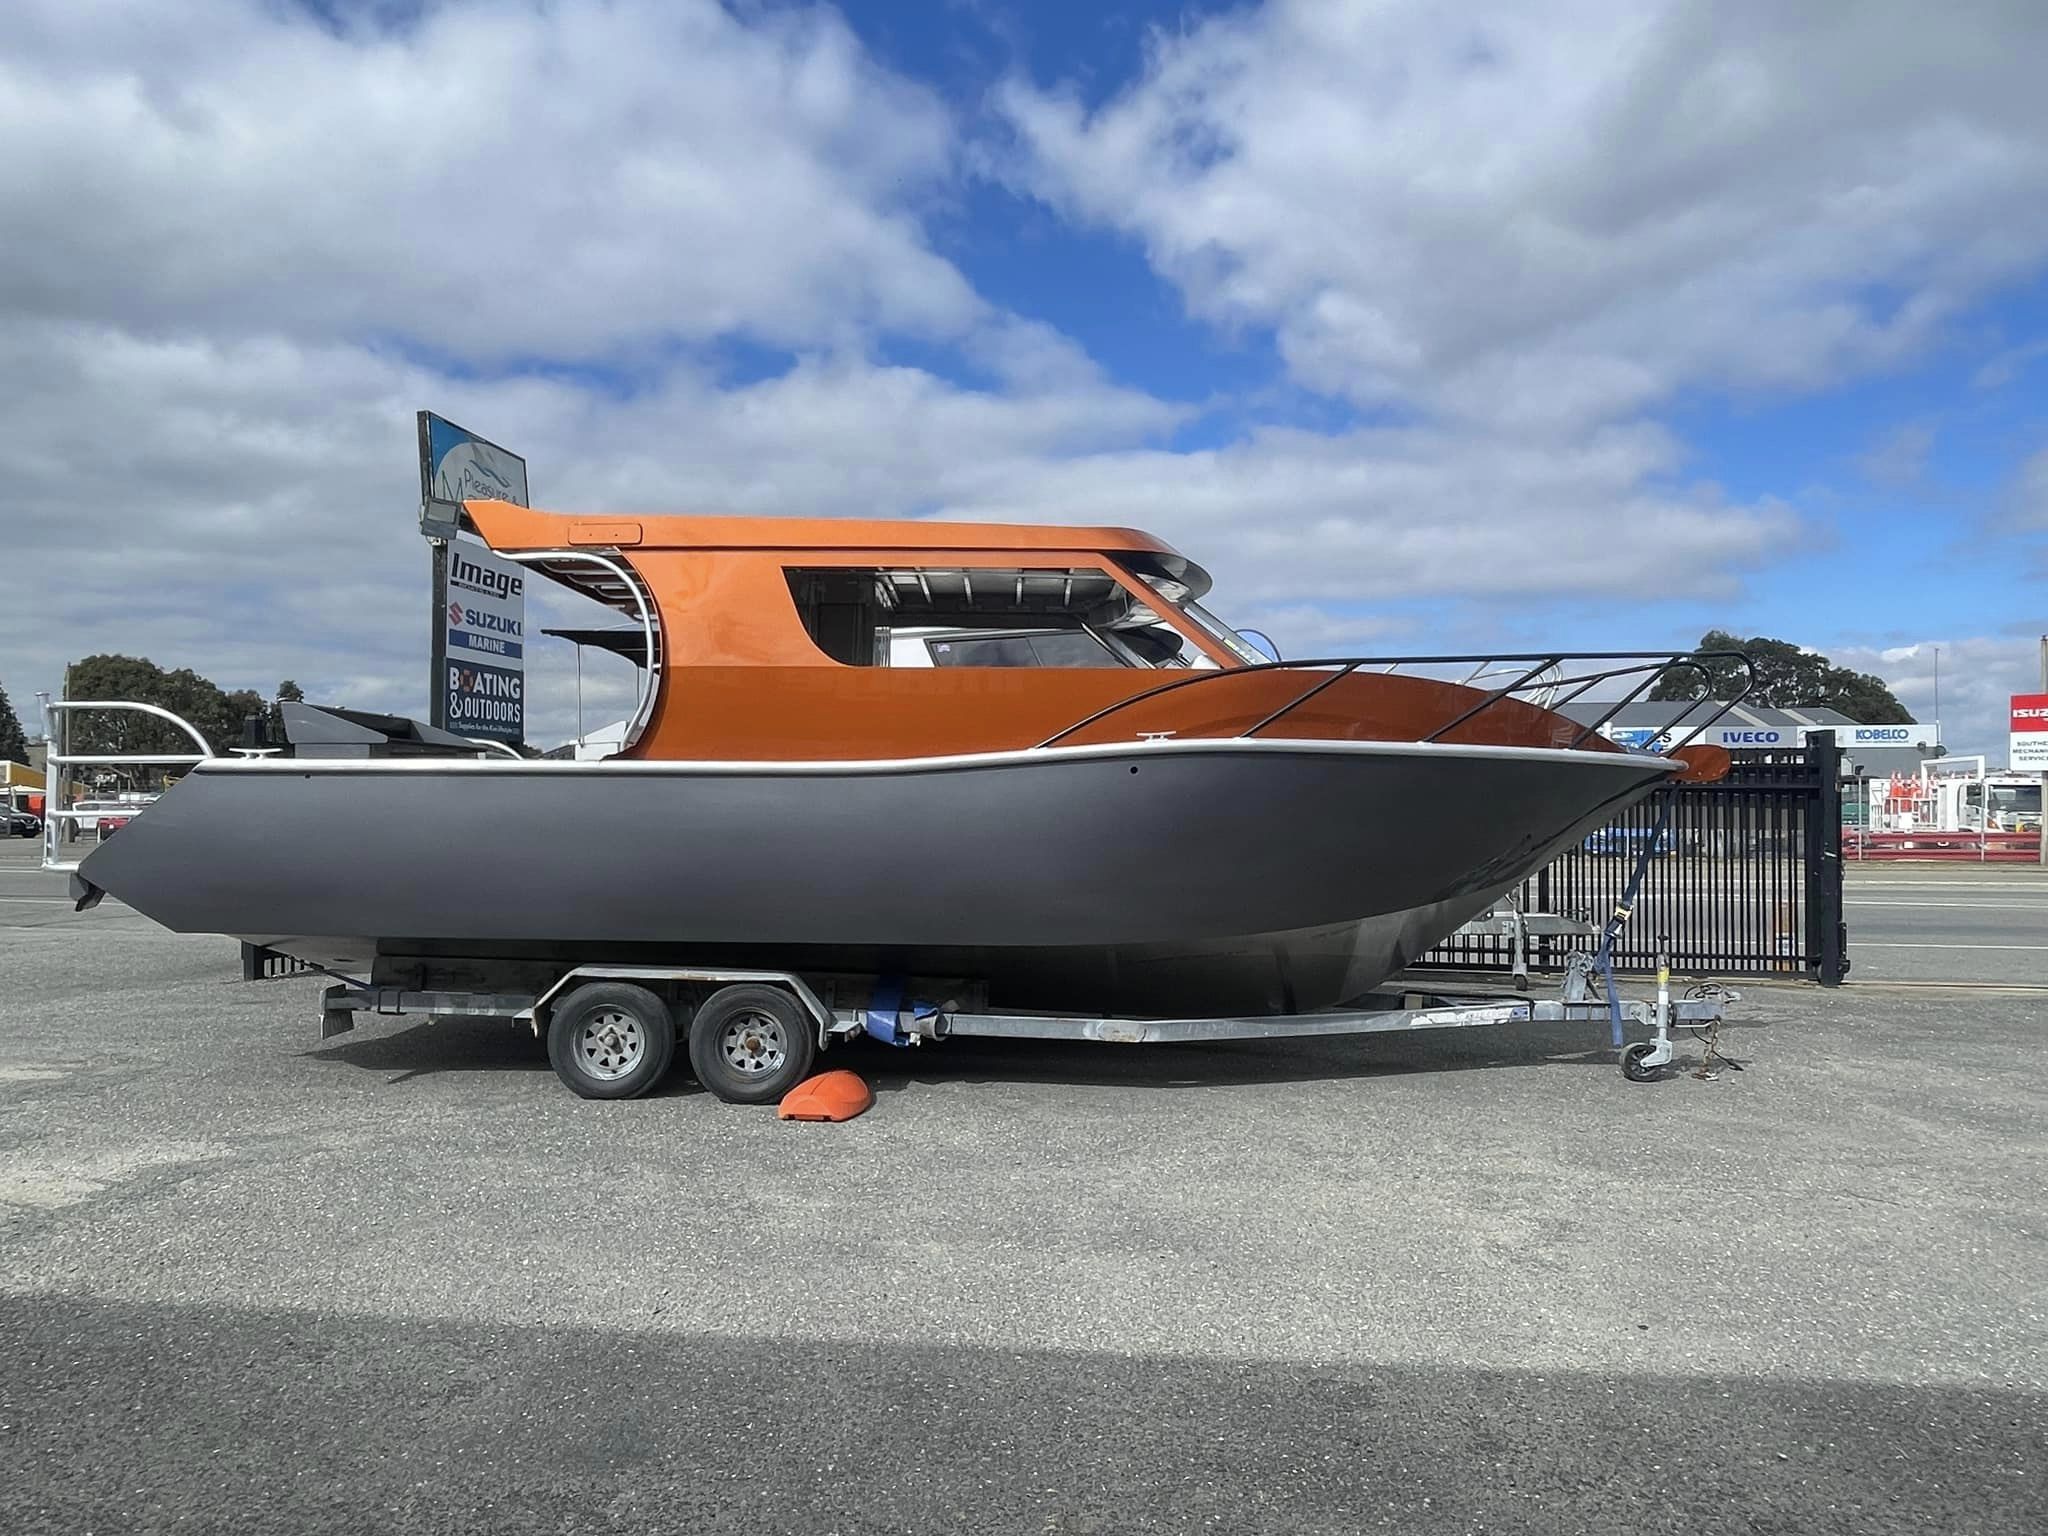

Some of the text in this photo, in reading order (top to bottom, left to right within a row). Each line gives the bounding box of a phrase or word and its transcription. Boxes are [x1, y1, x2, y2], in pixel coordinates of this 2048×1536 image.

[452, 553, 522, 600] Image
[465, 608, 523, 636] SUZUKI
[468, 634, 506, 654] MARINE
[1722, 731, 1780, 743] IVECO
[1855, 729, 1909, 740] KOBELCO
